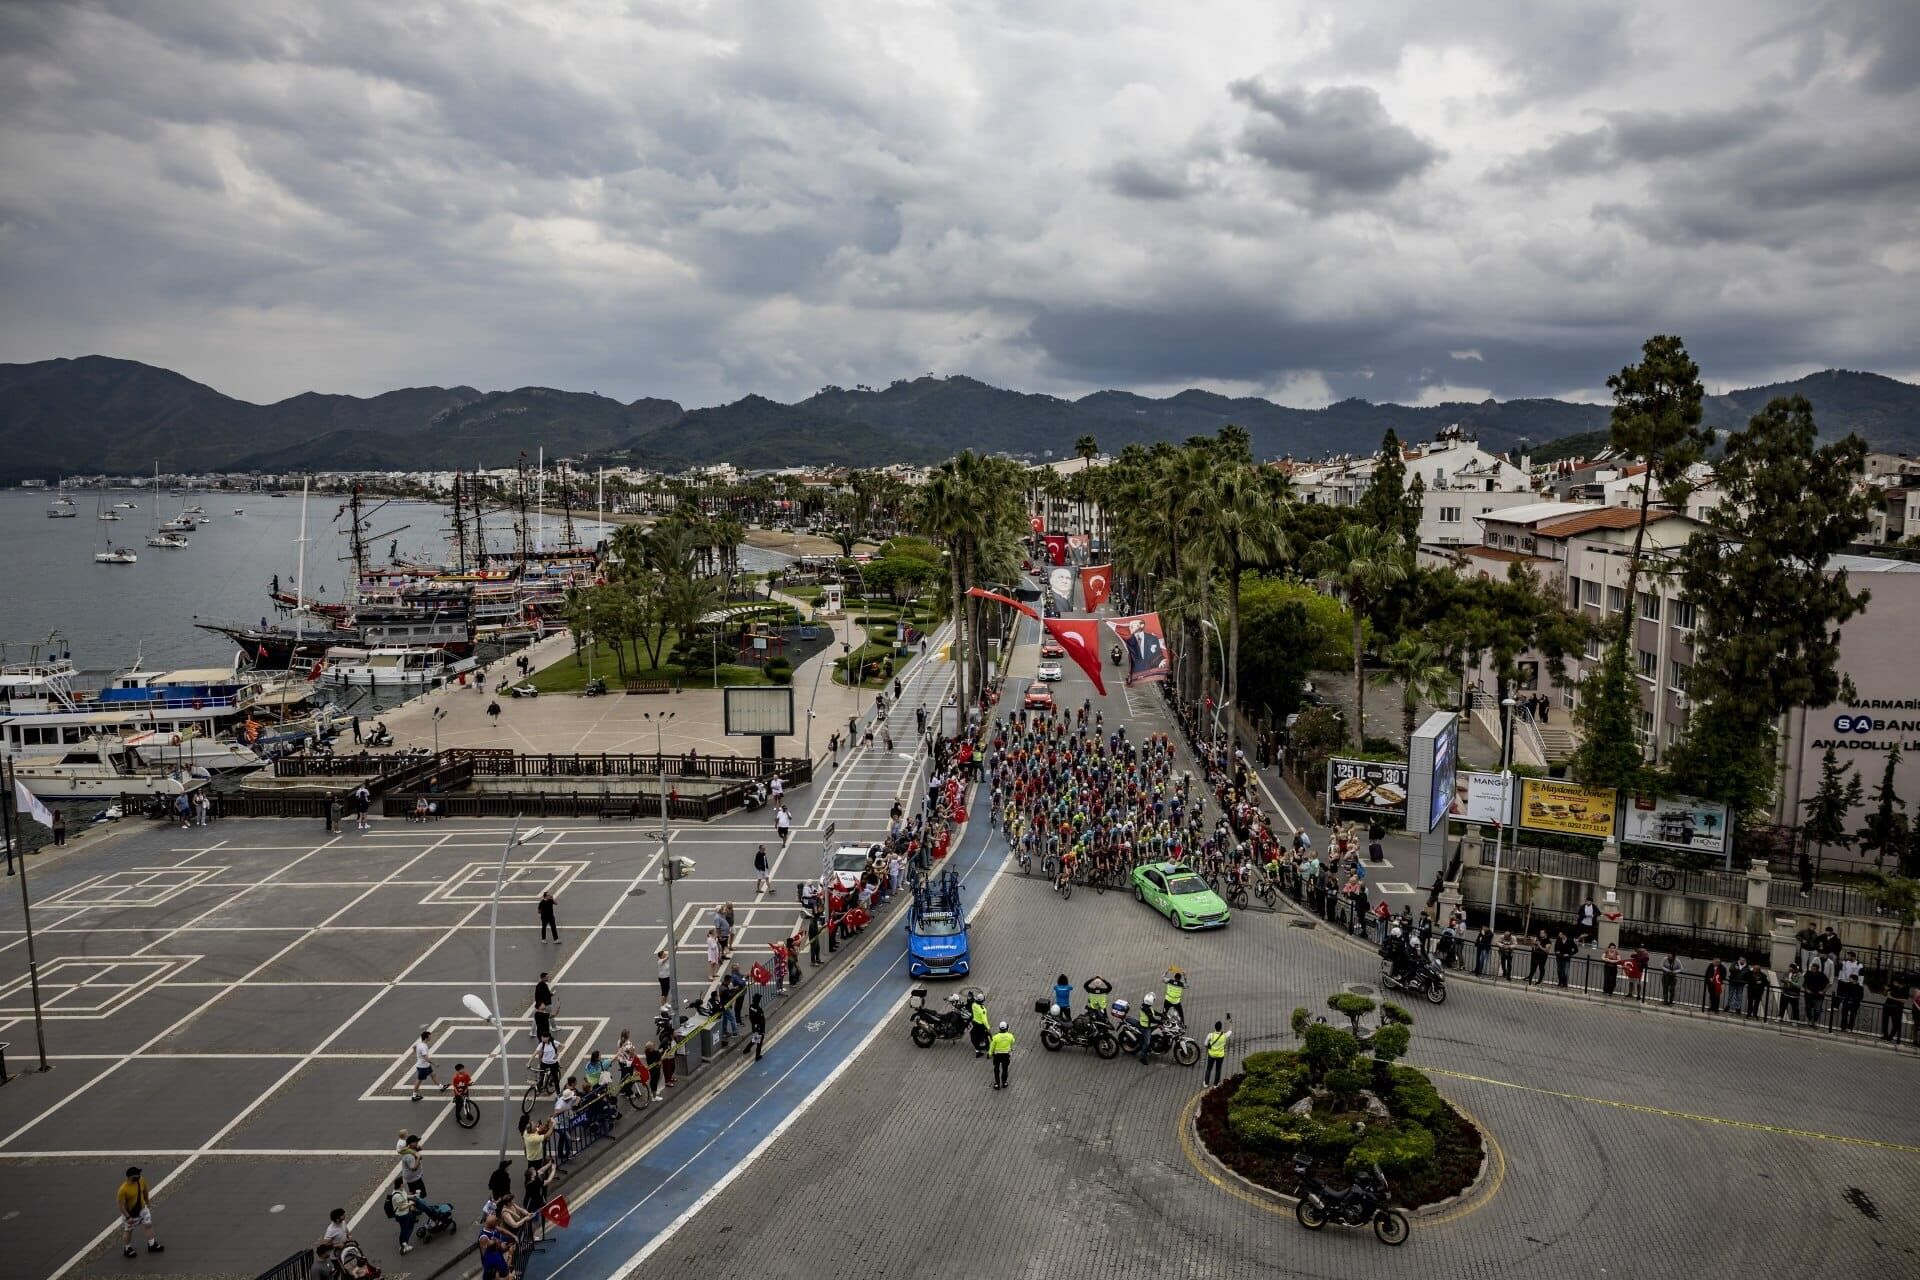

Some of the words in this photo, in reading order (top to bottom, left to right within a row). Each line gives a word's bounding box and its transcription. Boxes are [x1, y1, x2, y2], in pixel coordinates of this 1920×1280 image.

[1848, 699, 1920, 709] MARMARİ
[1812, 740, 1892, 750] ANADOLU
[1337, 764, 1354, 778] 125
[1356, 766, 1366, 780] TL
[1382, 769, 1400, 784] 130
[1402, 771, 1409, 784] T
[1541, 783, 1582, 796] Maydonoz
